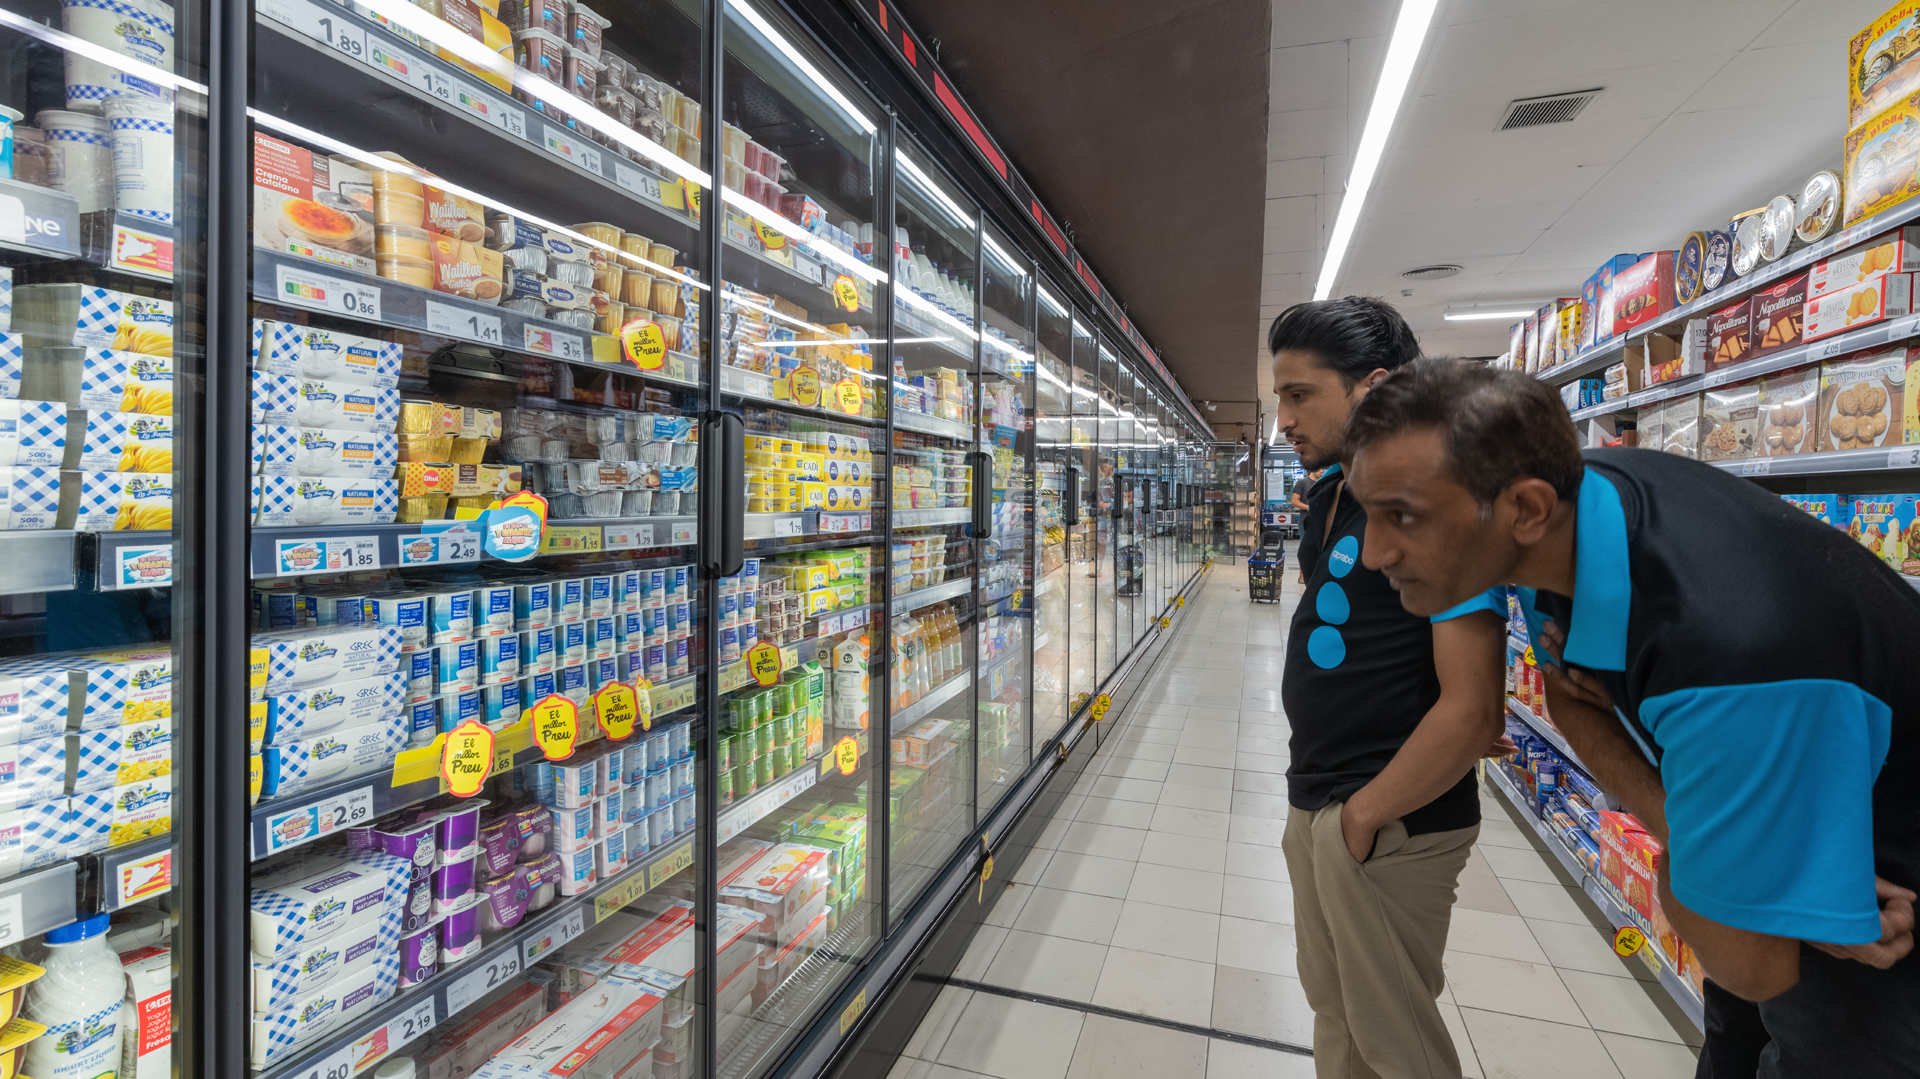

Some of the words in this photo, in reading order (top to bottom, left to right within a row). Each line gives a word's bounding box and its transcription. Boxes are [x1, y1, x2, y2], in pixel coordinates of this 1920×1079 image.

[1876, 6, 1914, 38] BIRBA
[319, 18, 362, 57] 1,89
[422, 73, 450, 99] 1,45
[1870, 112, 1904, 139] BIRBA
[265, 140, 290, 152] EROSKI
[255, 168, 288, 184] Crema
[255, 176, 300, 194] catalana
[431, 200, 467, 220] Natillas
[441, 261, 482, 280] Natillas
[1623, 278, 1644, 295] SURTIDO
[343, 292, 375, 315] 0,86
[1756, 292, 1804, 319] Napolitanas
[1709, 314, 1748, 337] Napolitanas
[638, 329, 649, 337] El
[633, 338, 657, 347] millor
[351, 348, 373, 357] NATURAL
[633, 345, 662, 357] Preu
[796, 386, 816, 395] Preu
[348, 396, 371, 404] NATURAL
[1580, 390, 1588, 408] OREO
[346, 443, 370, 451] NATURAL
[804, 461, 819, 471] CADÍ
[346, 490, 370, 498] NATURAL
[809, 491, 824, 501] CADÍ
[342, 548, 373, 567] 1,85
[450, 542, 475, 559] 2,49
[349, 640, 373, 651] GREC
[756, 658, 774, 666] millor
[760, 651, 768, 659] El
[755, 665, 777, 675] Preu
[357, 686, 379, 697] GREC
[611, 695, 622, 704] El
[549, 709, 560, 719] El
[606, 704, 628, 714] millor
[542, 720, 567, 730] millor
[605, 712, 633, 726] Preu
[359, 732, 381, 744] GREC
[463, 737, 475, 748] El
[541, 729, 572, 743] Preu
[454, 749, 480, 760] millor
[452, 759, 483, 774] Preu
[333, 805, 367, 827] 2,69
[355, 898, 379, 912] NATURAL
[561, 923, 580, 940] 1,04
[348, 946, 372, 961] NATURAL
[486, 960, 518, 989] 2,29
[346, 992, 370, 1008] NATURAL
[402, 1014, 431, 1040] 2,19
